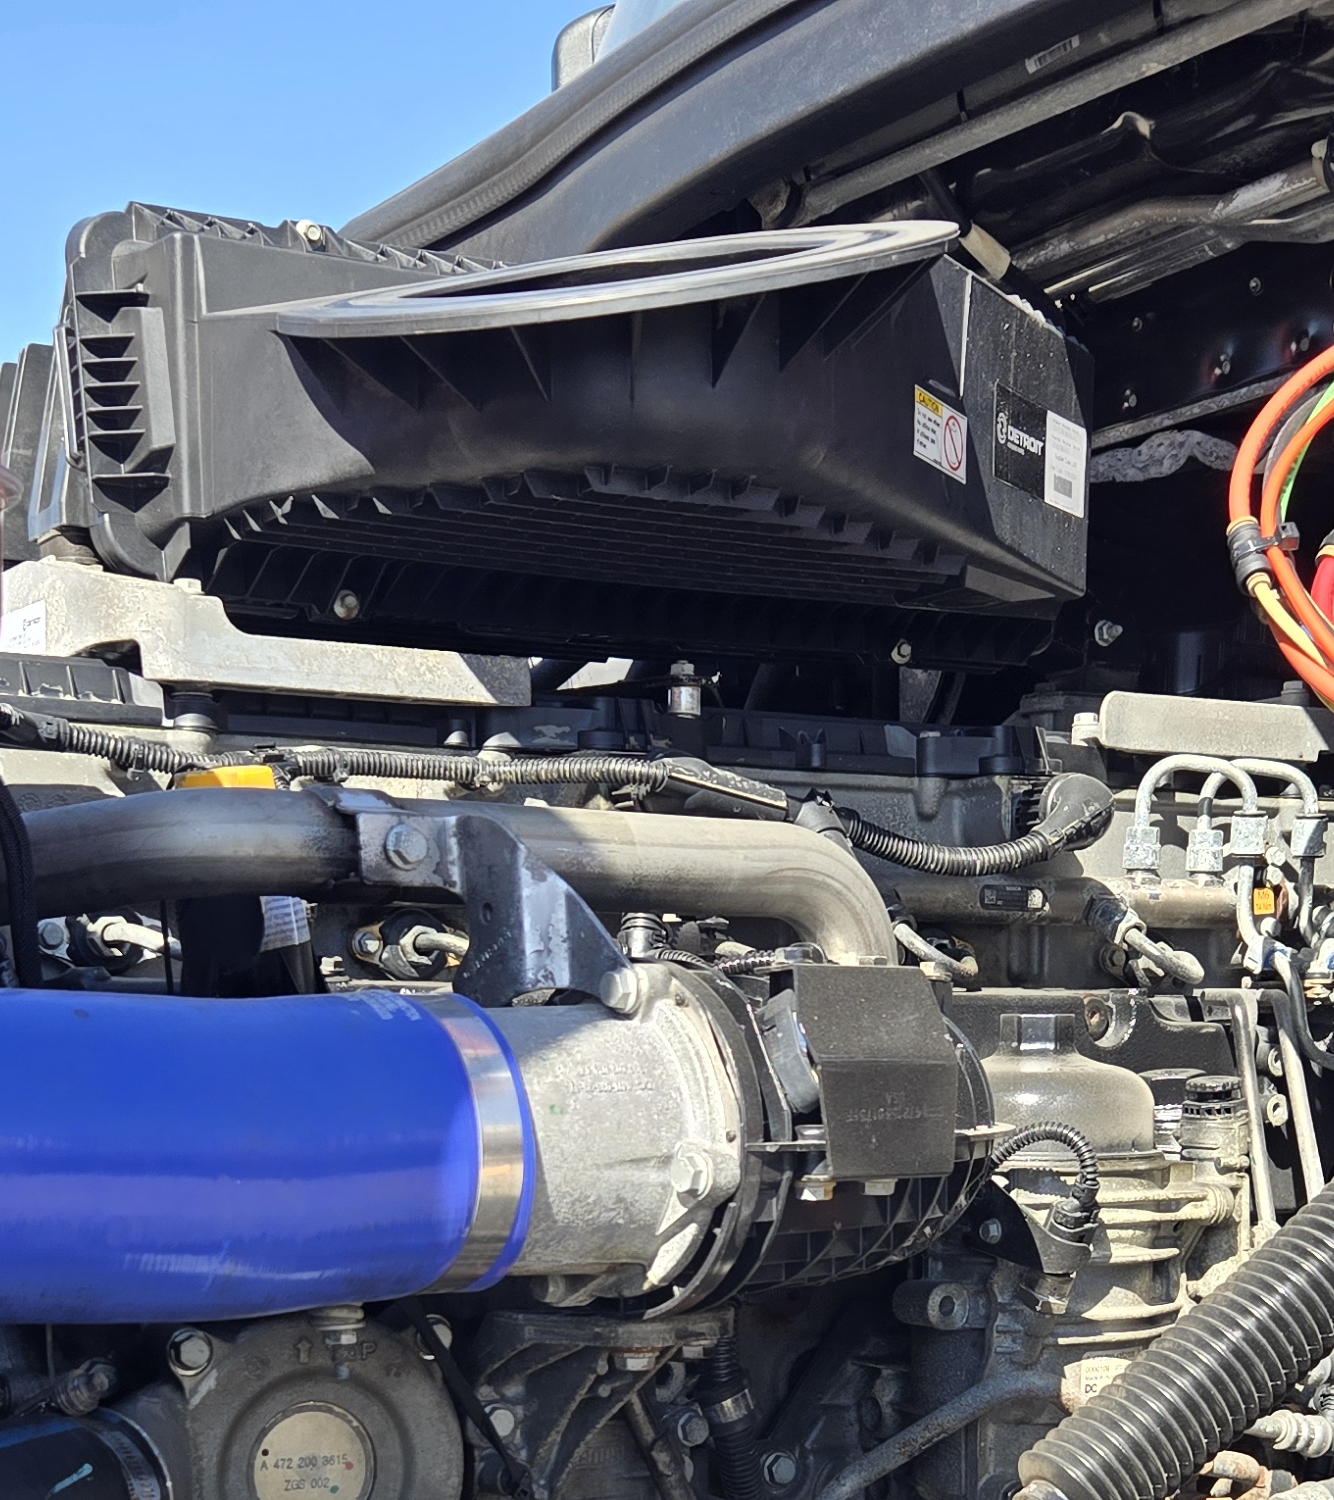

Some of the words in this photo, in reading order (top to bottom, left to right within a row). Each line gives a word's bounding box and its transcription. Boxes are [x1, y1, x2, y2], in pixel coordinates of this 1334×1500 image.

[1007, 425, 1044, 456] DETROIT
[260, 1460, 269, 1471] A
[273, 1456, 294, 1470] 472
[298, 1454, 317, 1468] 200
[284, 1479, 306, 1492] ZGS
[310, 1477, 331, 1490] 002
